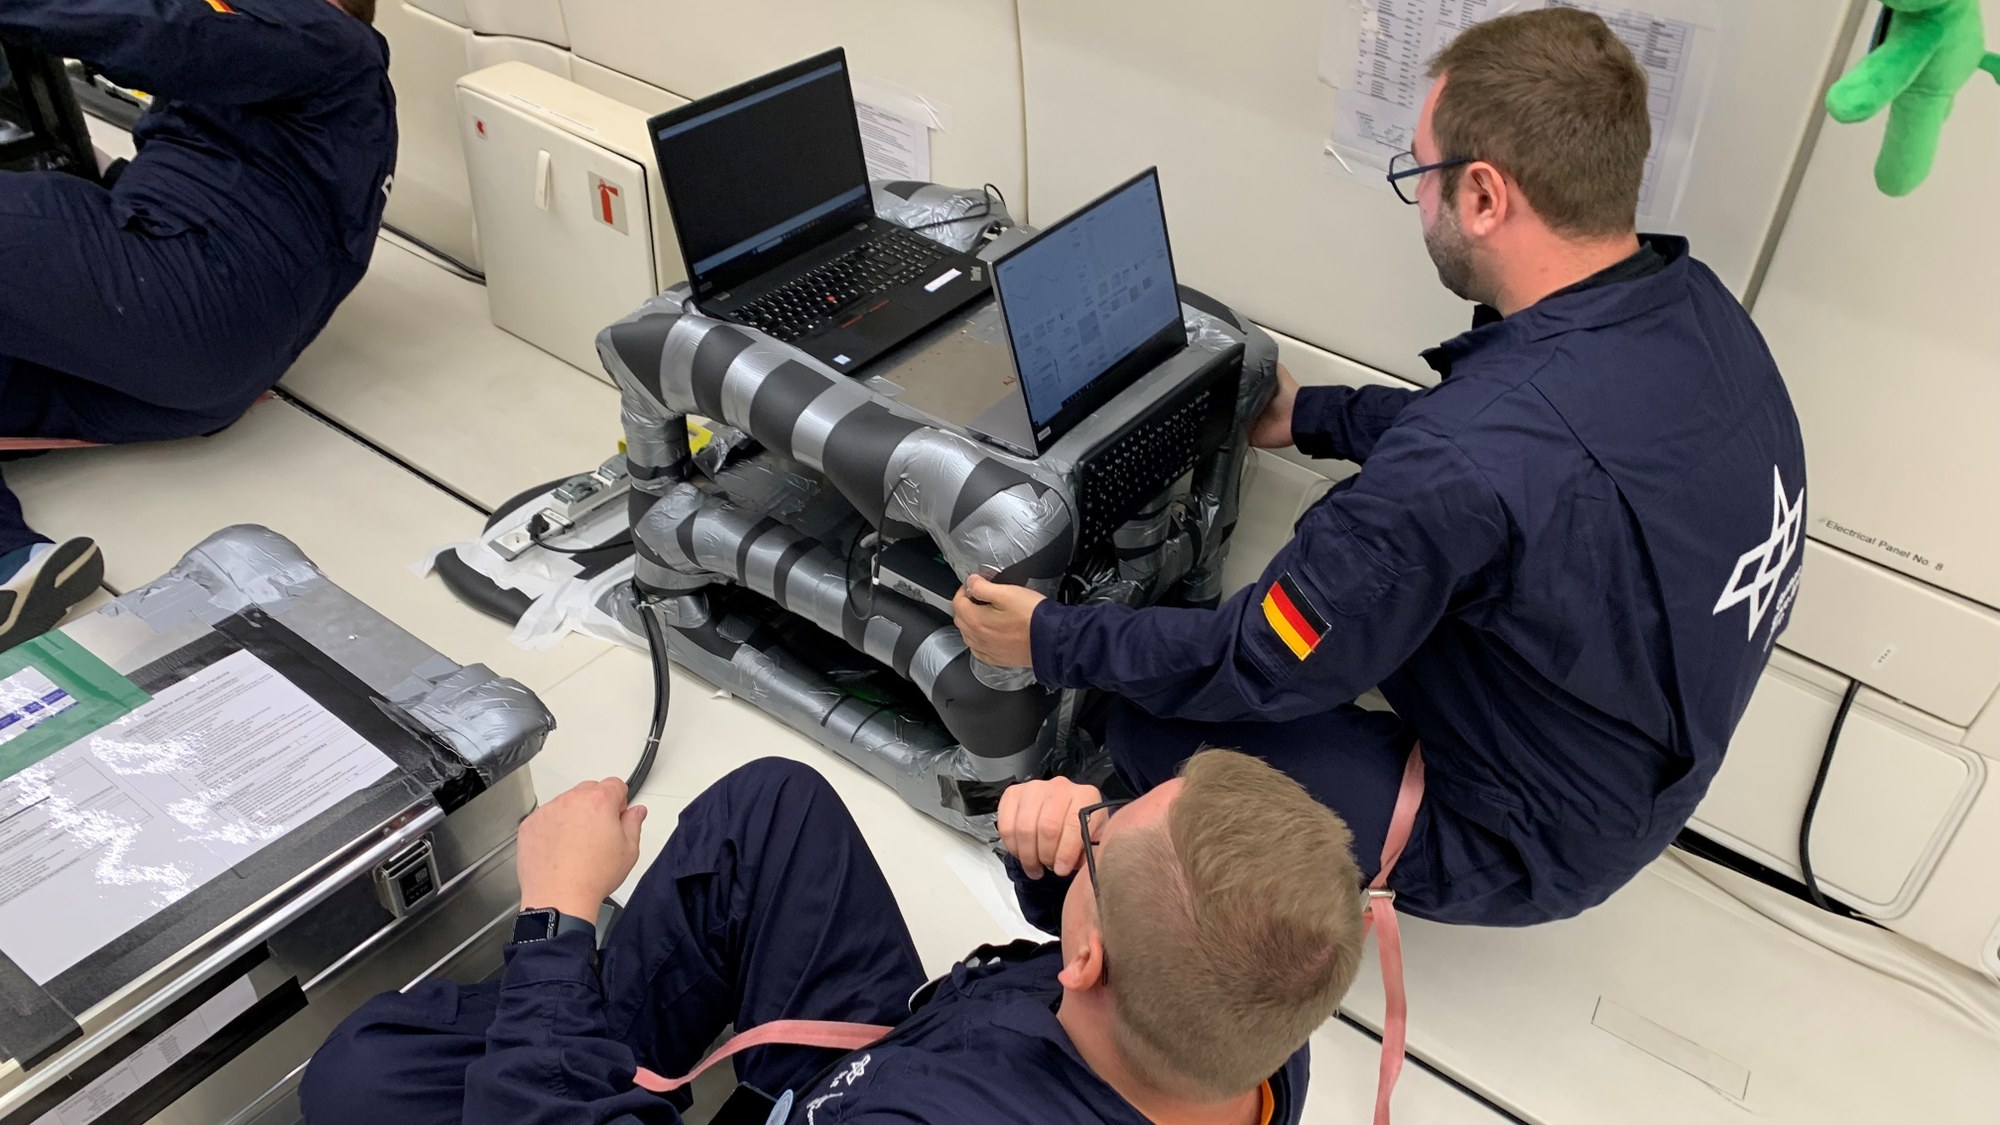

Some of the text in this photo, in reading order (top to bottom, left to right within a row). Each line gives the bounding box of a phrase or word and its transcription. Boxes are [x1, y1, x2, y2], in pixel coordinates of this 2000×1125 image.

[1825, 520, 1877, 545] Electrical
[1878, 539, 1911, 559] Panel
[1935, 562, 1944, 572] 8
